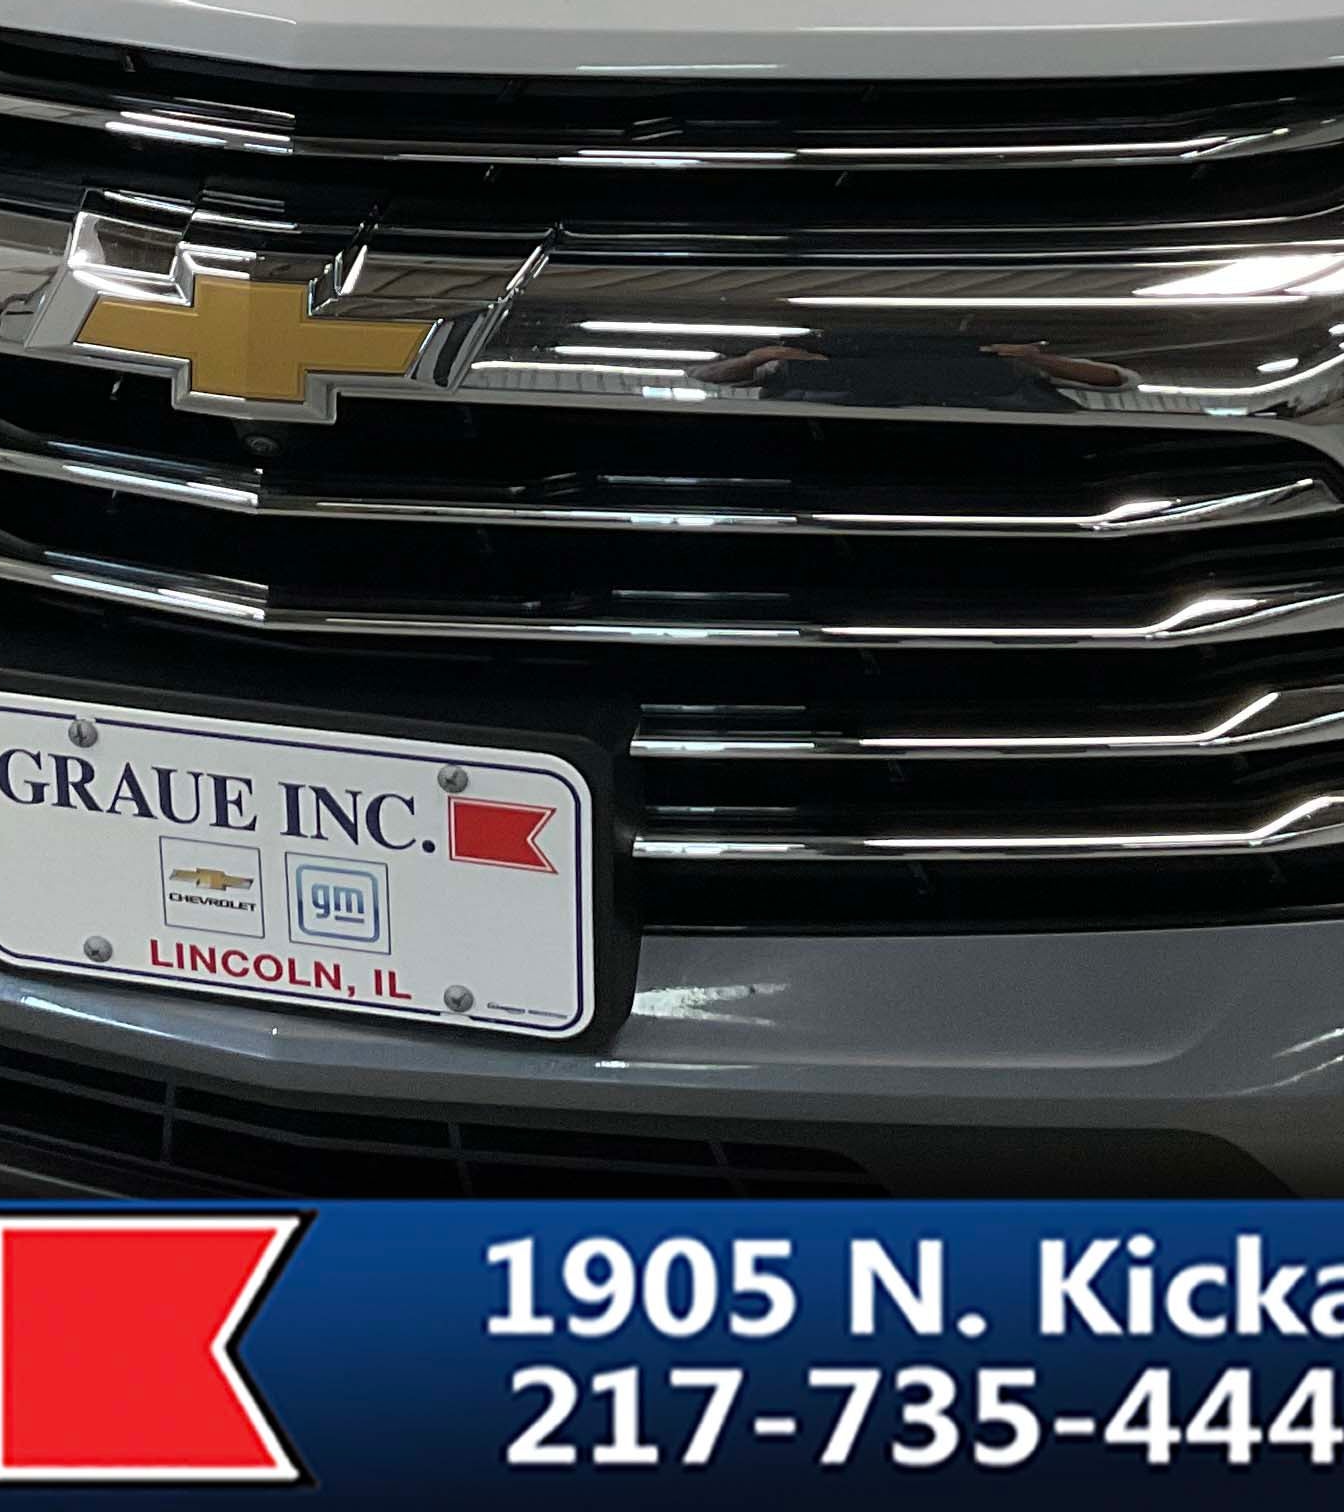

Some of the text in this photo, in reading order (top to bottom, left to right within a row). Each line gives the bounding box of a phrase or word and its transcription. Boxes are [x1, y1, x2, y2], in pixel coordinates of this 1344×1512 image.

[279, 781, 437, 854] INC.
[168, 891, 256, 913] CHEVROLET
[311, 883, 365, 924] gm
[150, 938, 413, 1000] LINCOLN, IL
